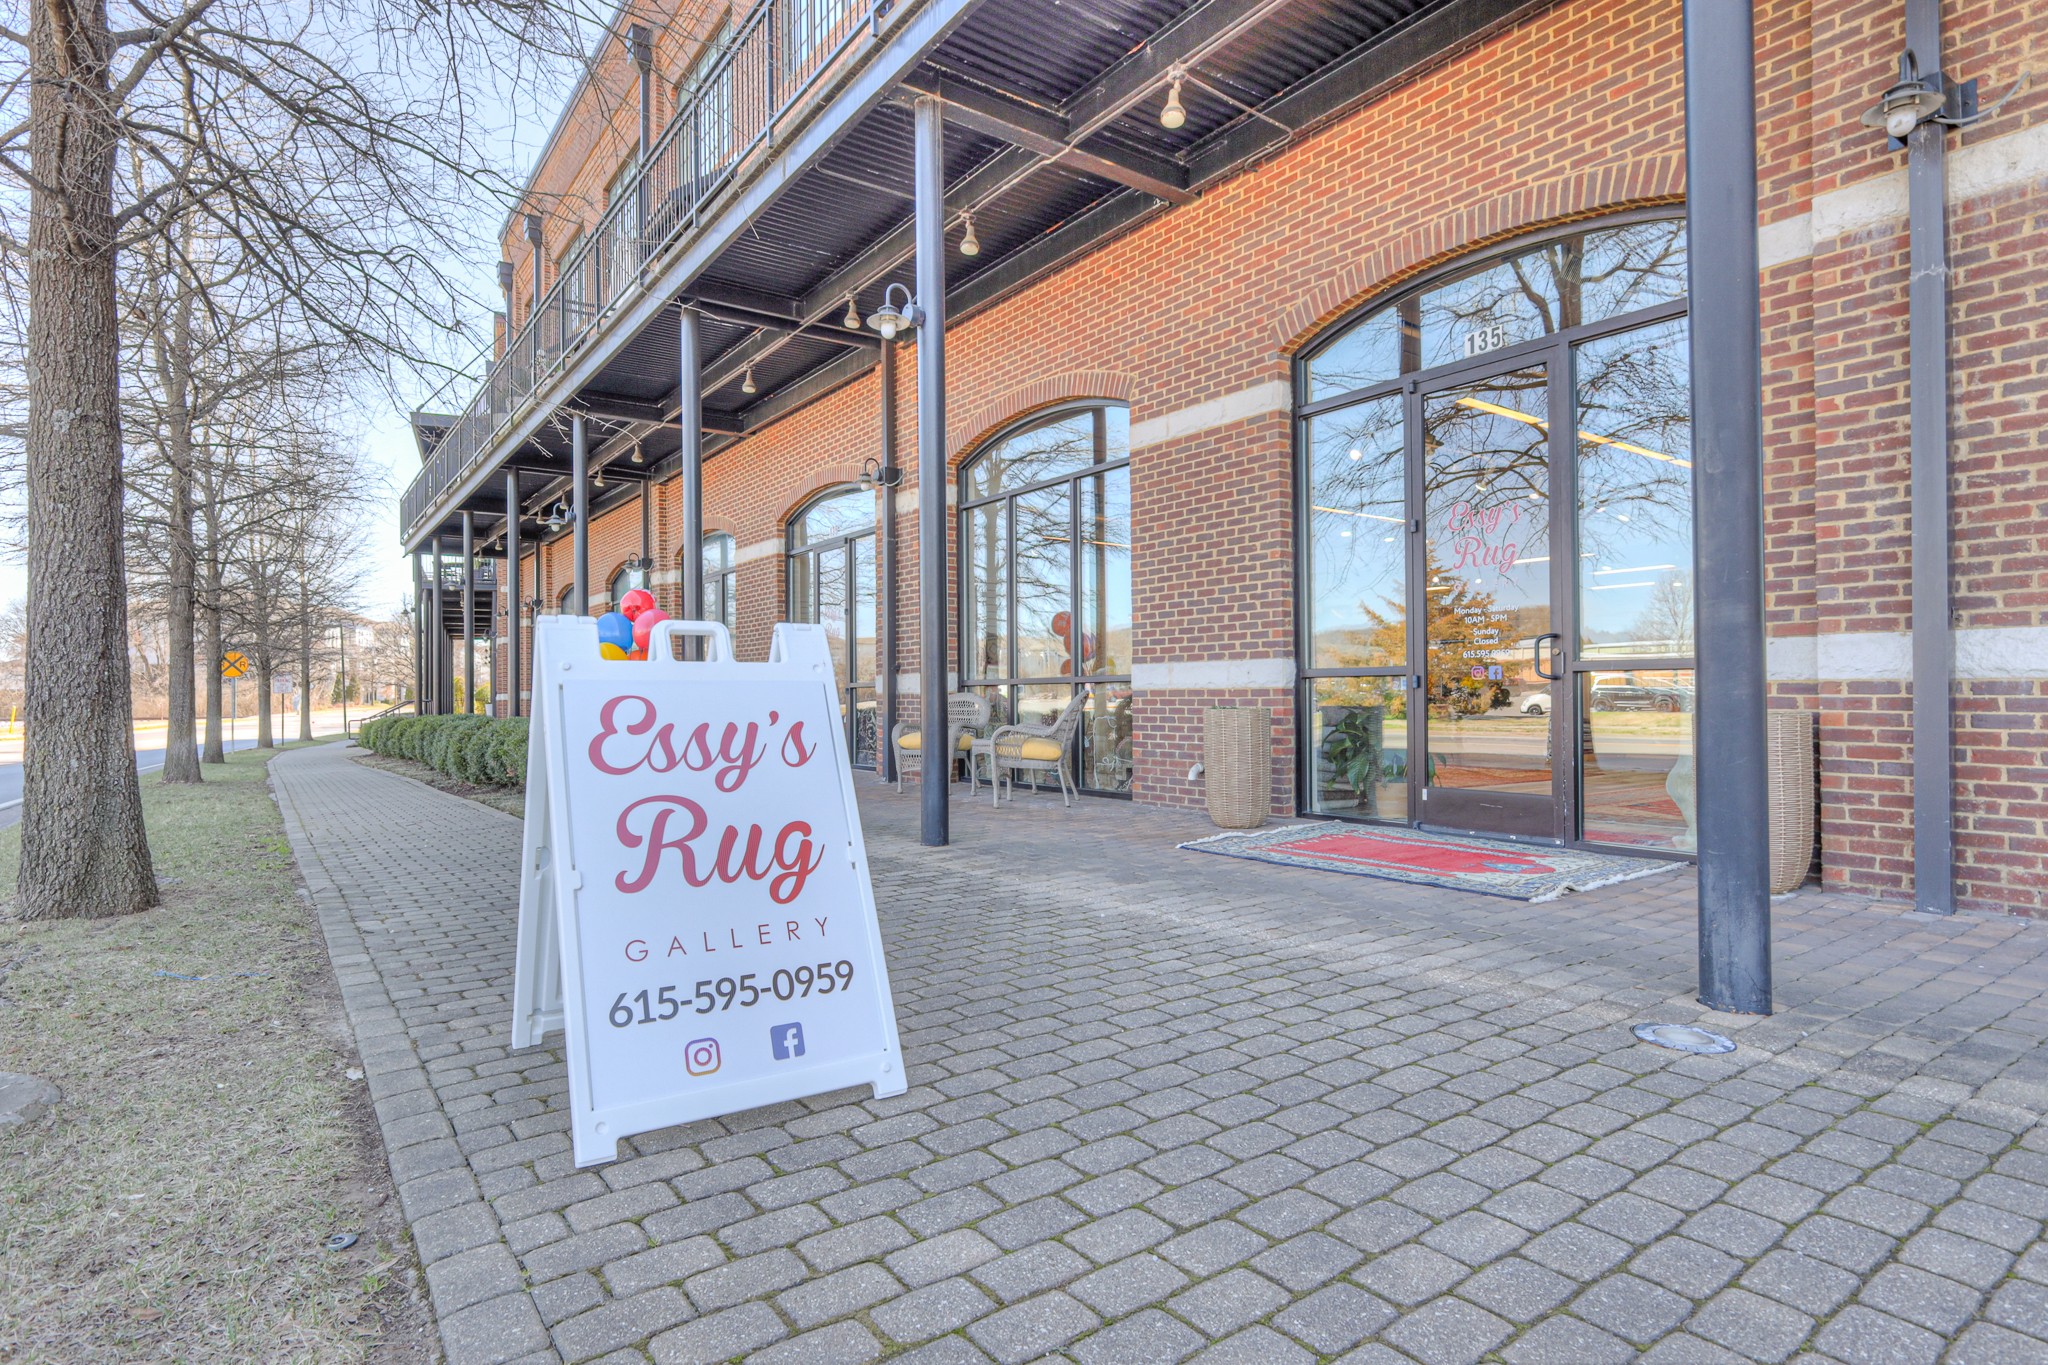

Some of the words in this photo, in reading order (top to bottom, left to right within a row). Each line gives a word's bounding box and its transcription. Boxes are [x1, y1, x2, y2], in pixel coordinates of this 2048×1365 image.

[1467, 326, 1503, 354] 135
[1448, 500, 1521, 534] Essy's
[1453, 536, 1517, 574] Rug
[1454, 607, 1482, 615] Monday
[1488, 604, 1519, 613] Saturday
[1465, 616, 1485, 624] 10AM
[1491, 614, 1507, 622] 5PM
[1473, 628, 1498, 636] Sunday
[1474, 637, 1498, 645] Closed
[588, 694, 817, 793] Essy's
[614, 794, 825, 905] Rug
[625, 916, 829, 962] GALLERY
[608, 959, 854, 1028] 615-595-0959
